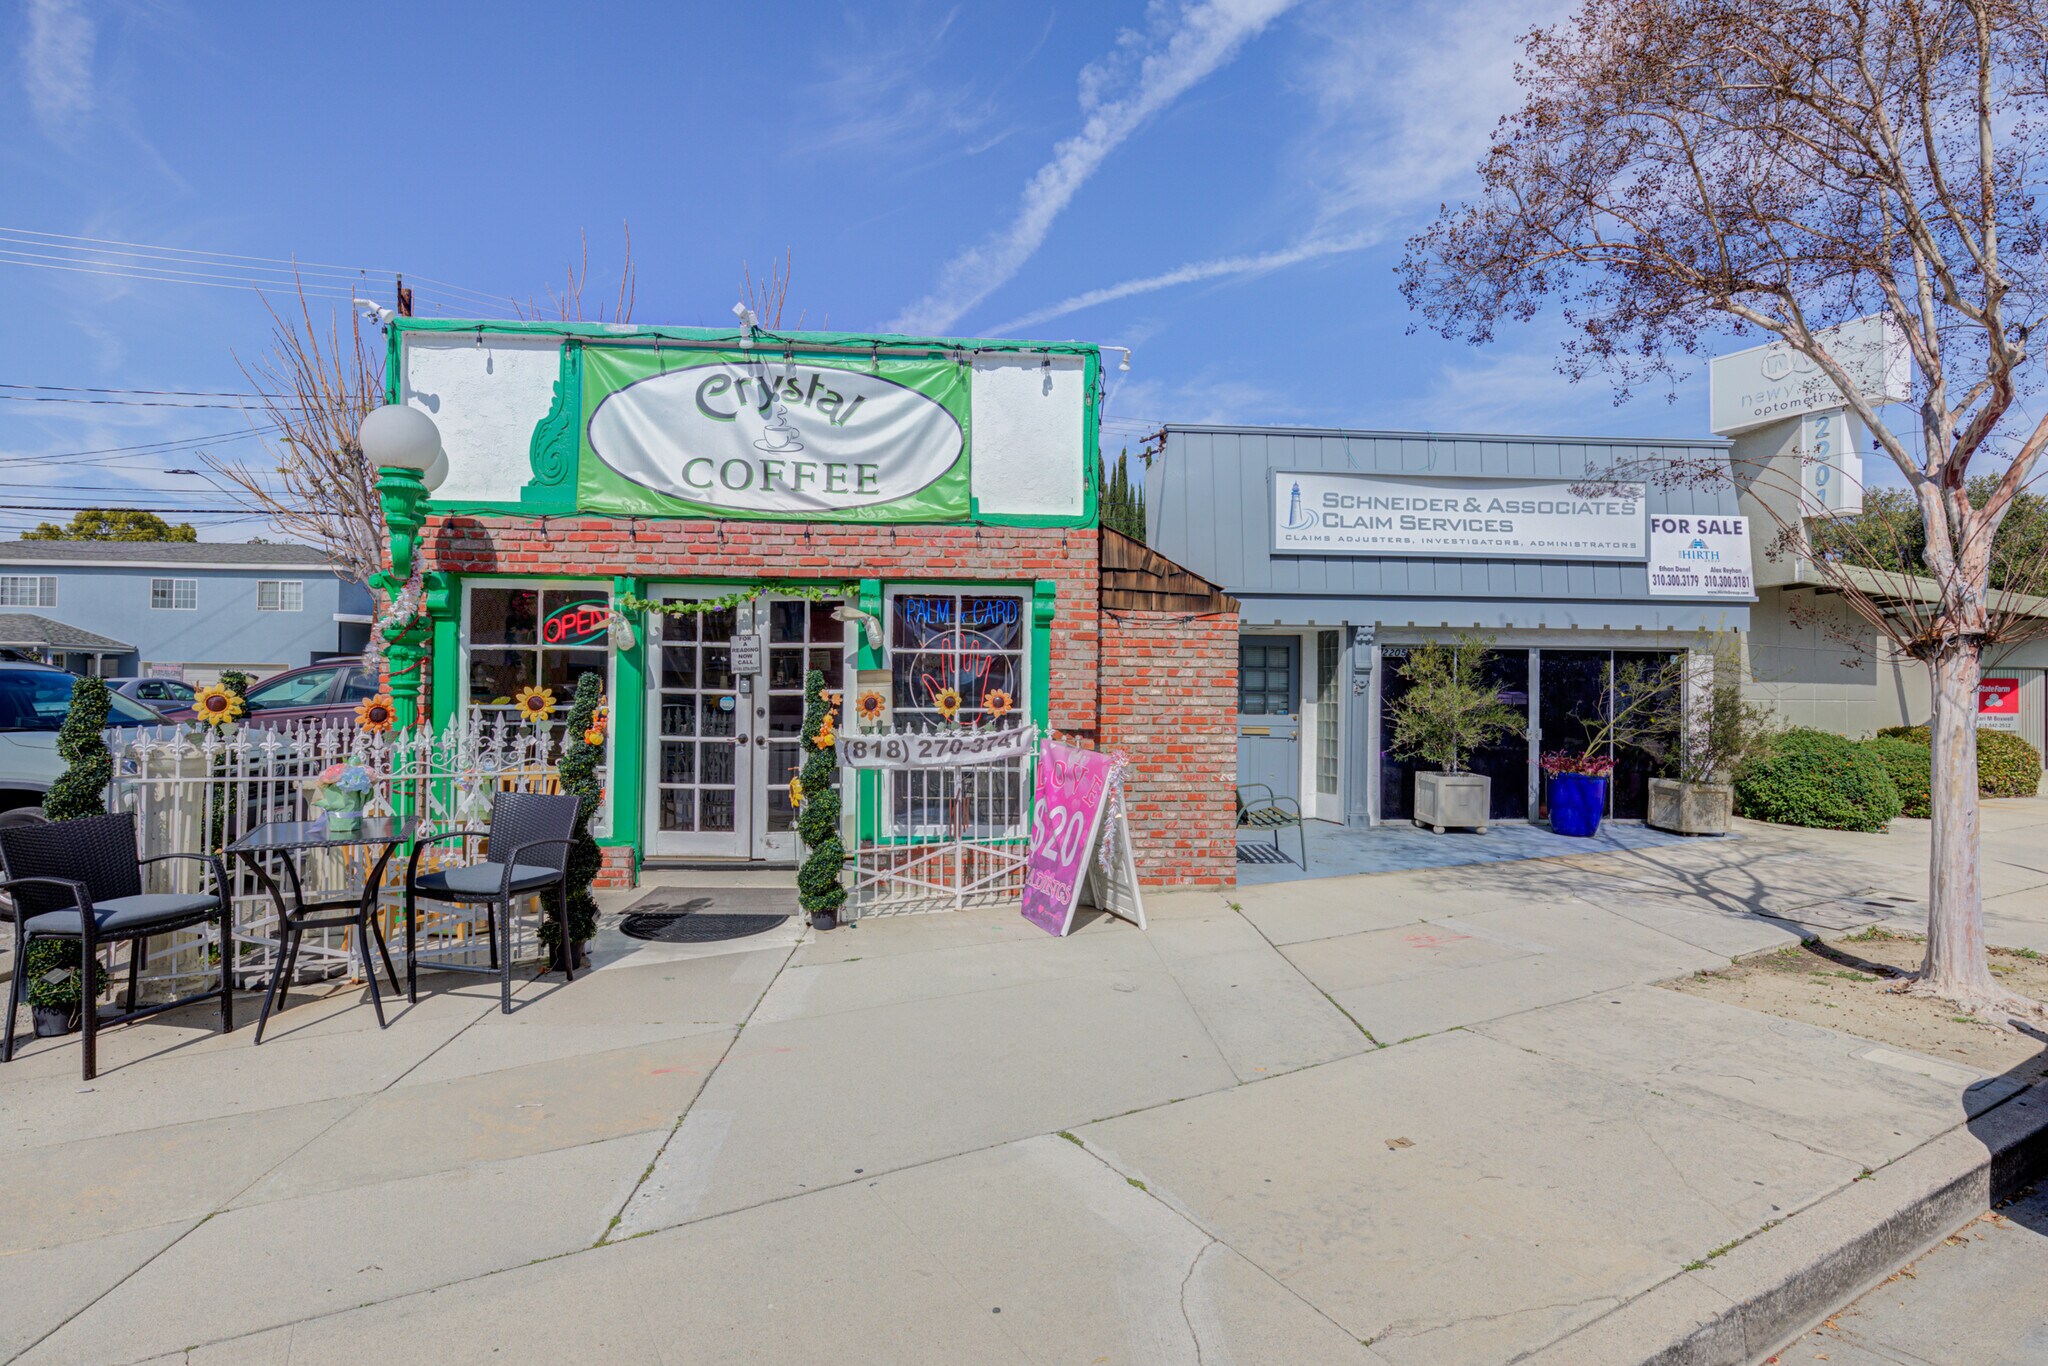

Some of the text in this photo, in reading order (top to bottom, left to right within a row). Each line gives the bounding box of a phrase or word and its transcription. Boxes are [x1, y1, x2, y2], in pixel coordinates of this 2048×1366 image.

[695, 373, 867, 427] Crystal
[1754, 391, 1835, 416] optometry
[681, 457, 880, 494] COFFEE
[1814, 416, 1831, 512] 2201
[1322, 492, 1637, 516] SCHNEIDER & ASSOCIATES
[1322, 512, 1514, 533] CLAIM SERVICES
[1651, 518, 1743, 536] FOR SALE
[1285, 534, 1638, 549] CLAIMS ADJUSTERS, INVESTIGATORS, ADMINISTRATORS
[1682, 550, 1720, 560] HIRTH
[1652, 574, 1699, 587] 310.300.3179
[1704, 575, 1750, 588] 310.300.3181
[543, 604, 609, 643] OPEN
[906, 598, 950, 624] PALM
[972, 599, 1018, 625] CARD
[1382, 648, 1407, 657] 2205
[843, 730, 1024, 765] (818) 270-3747
[1036, 759, 1103, 809] LOVE
[1029, 796, 1085, 868] $20
[1025, 866, 1072, 906] ADINGS
